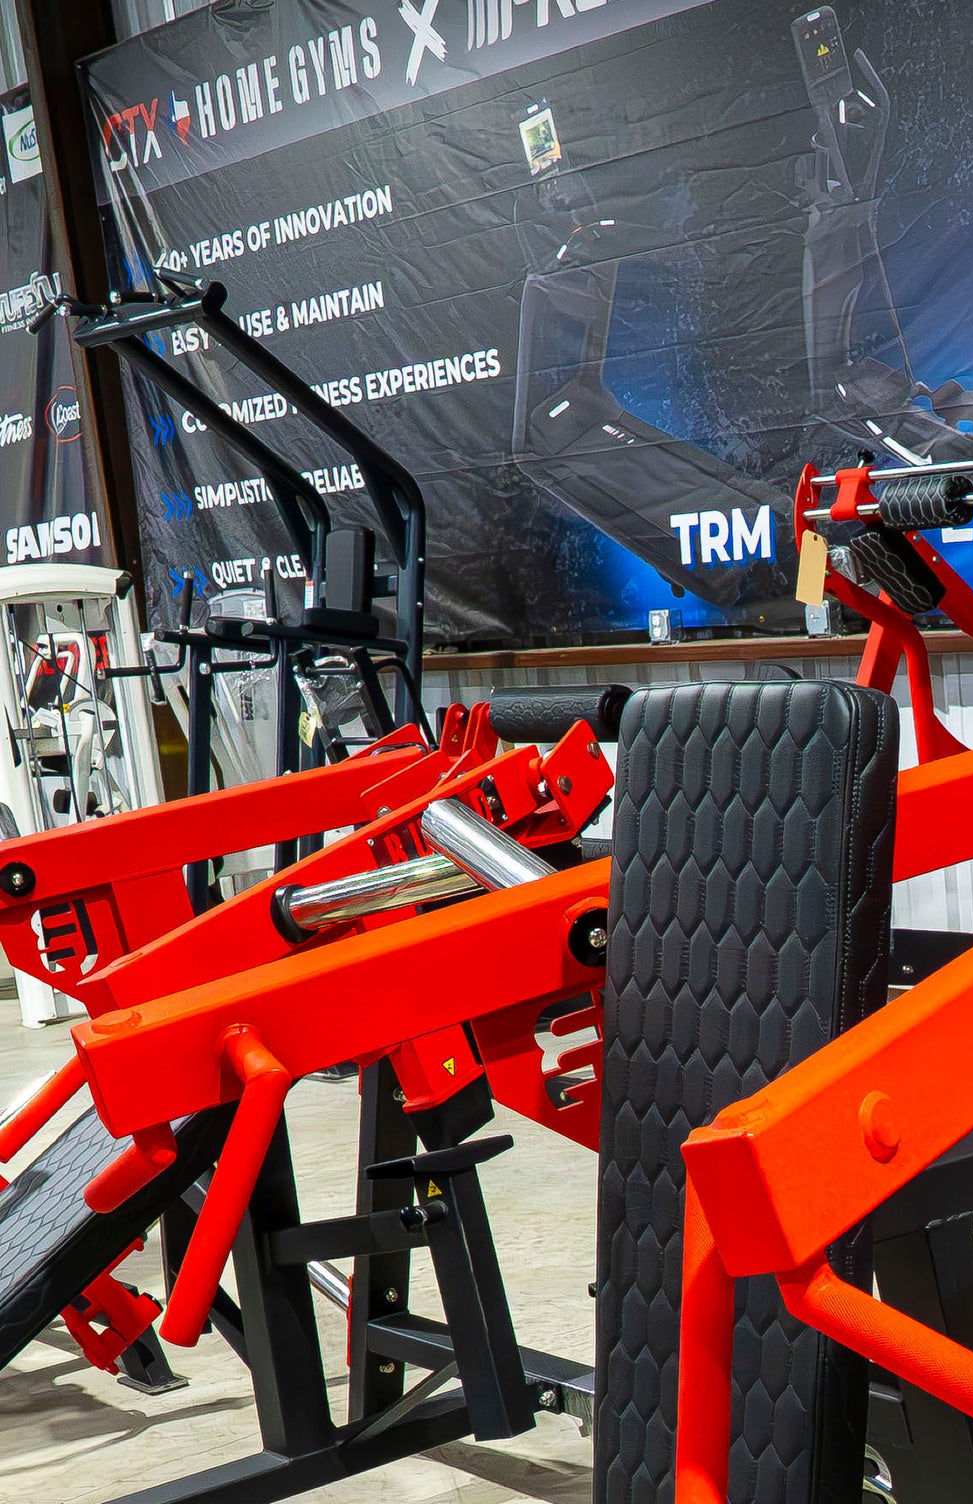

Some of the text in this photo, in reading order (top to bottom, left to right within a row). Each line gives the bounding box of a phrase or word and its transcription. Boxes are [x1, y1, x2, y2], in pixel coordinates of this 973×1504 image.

[195, 55, 283, 139] HOME
[288, 16, 382, 105] GYMS
[189, 229, 245, 268] YEARS
[247, 221, 272, 252] OF
[273, 185, 394, 245] INNOVATION
[239, 309, 275, 340] USE
[275, 305, 291, 333] &
[291, 280, 386, 329] MAINTAIN
[366, 347, 501, 401] EXPERIENCES
[670, 503, 772, 566] TRM
[211, 557, 256, 589] QUIET
